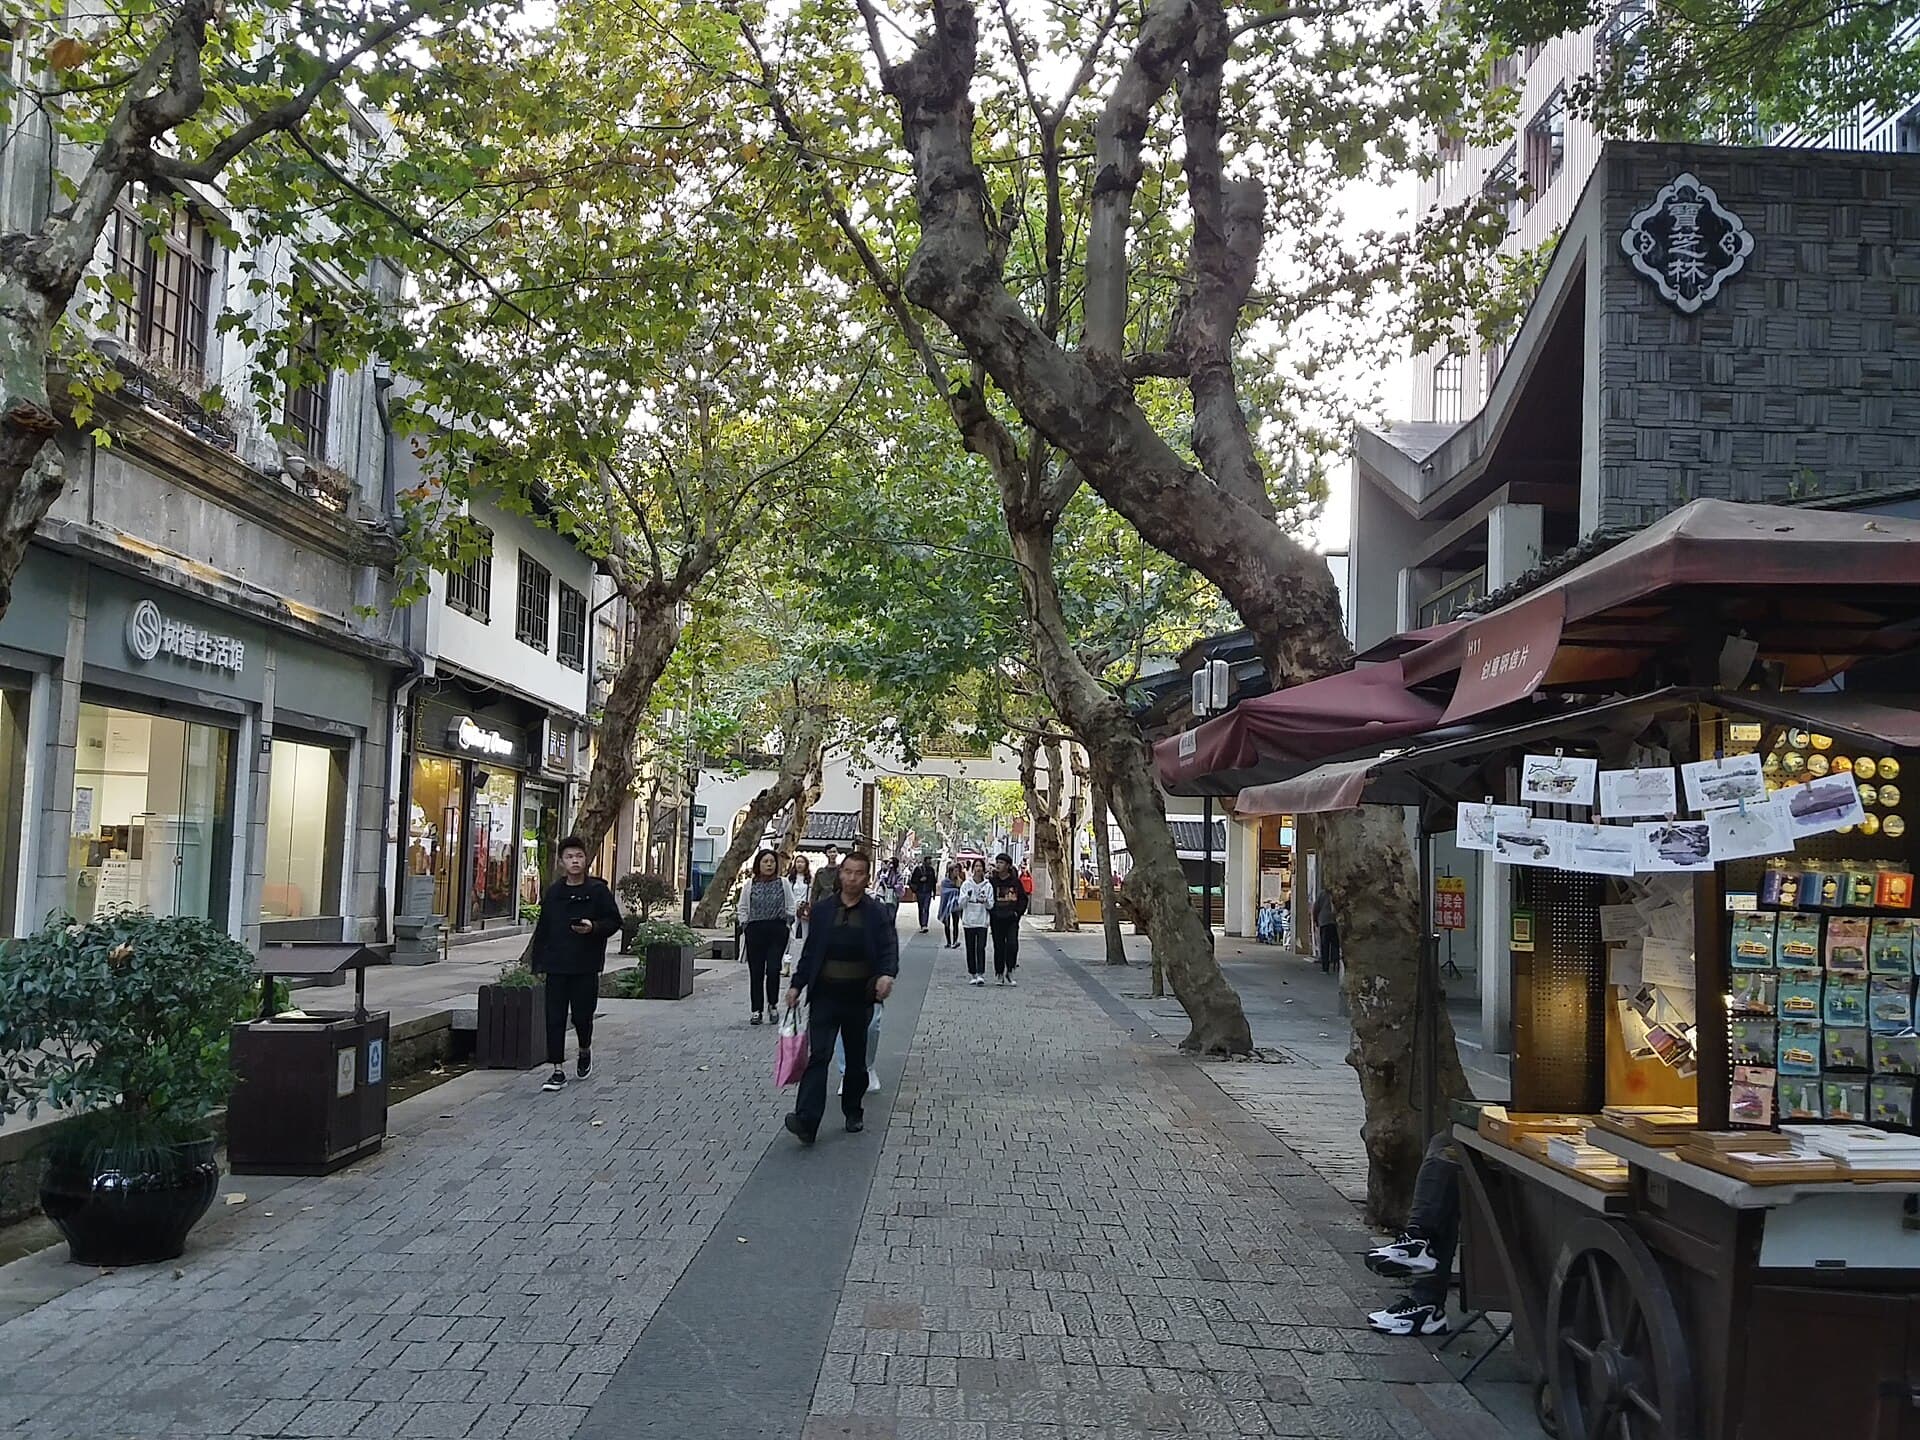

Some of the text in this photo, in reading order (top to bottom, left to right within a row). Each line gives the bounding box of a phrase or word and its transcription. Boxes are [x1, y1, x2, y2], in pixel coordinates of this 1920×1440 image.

[1668, 202, 1708, 284] 寶芝林
[162, 617, 245, 672] 树德生活馆
[1481, 644, 1529, 680] 创意明信片
